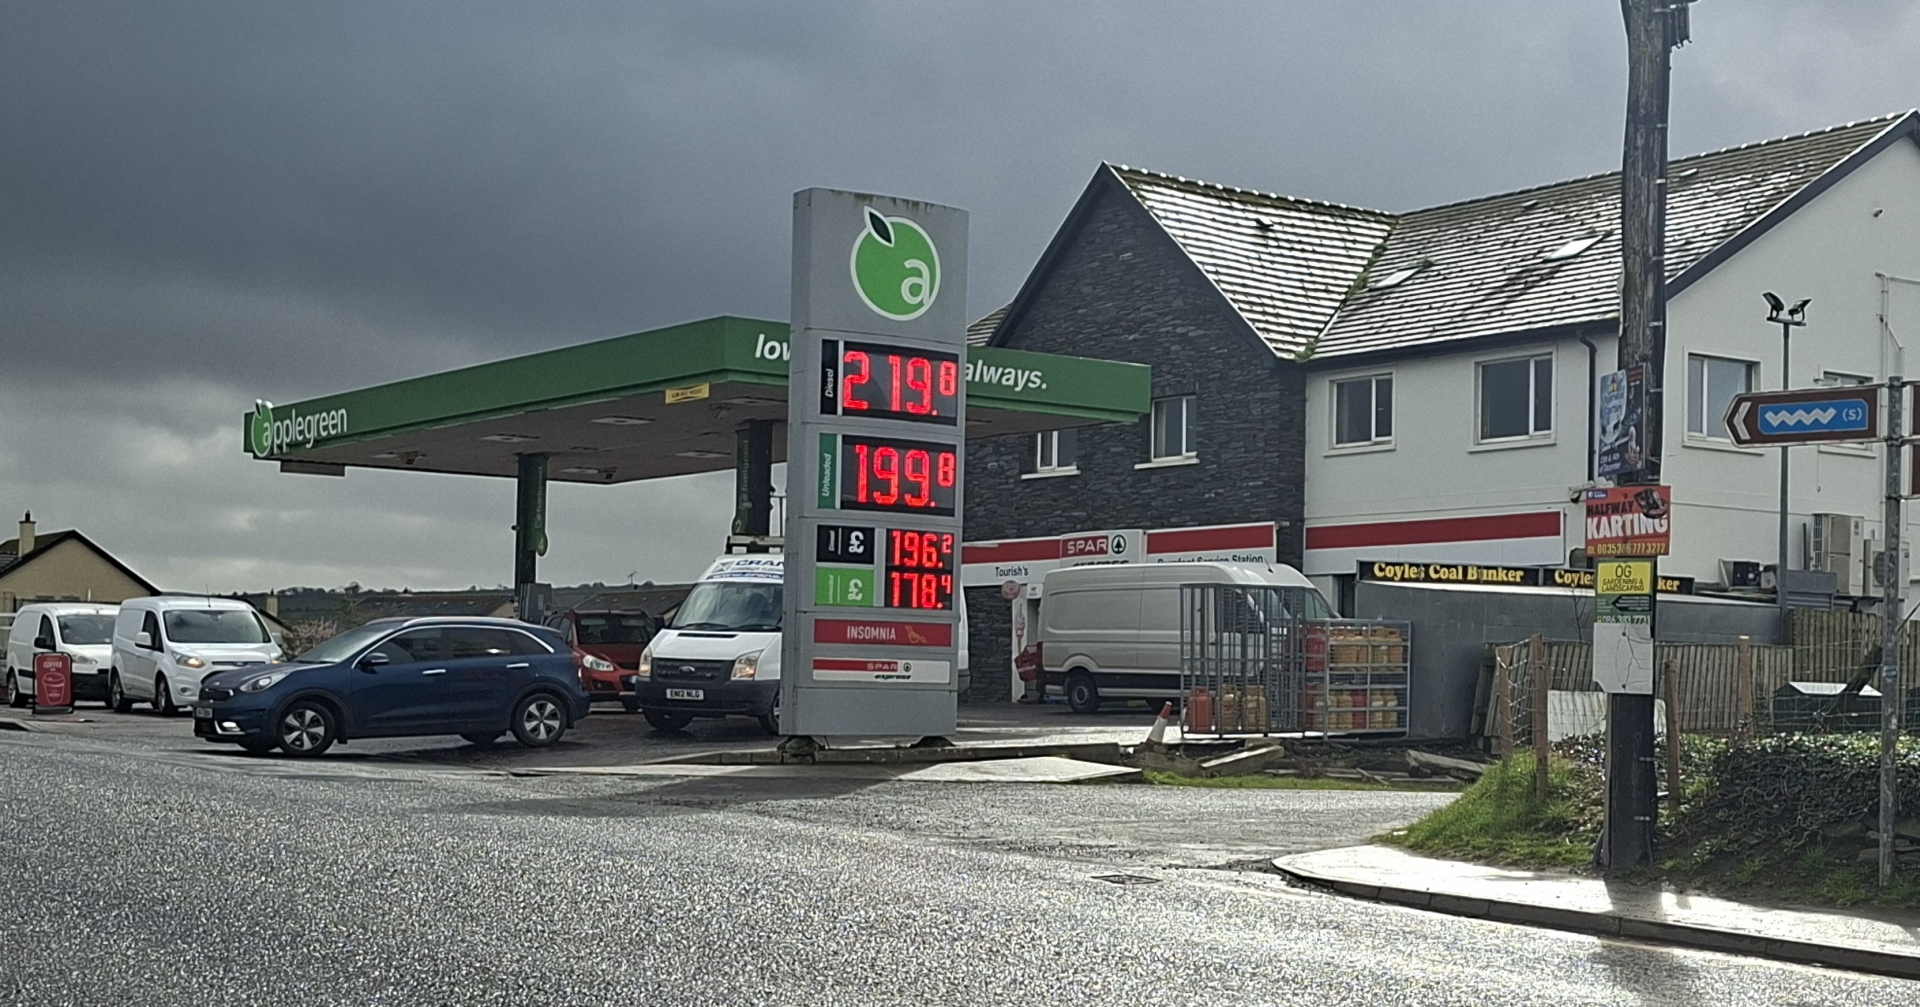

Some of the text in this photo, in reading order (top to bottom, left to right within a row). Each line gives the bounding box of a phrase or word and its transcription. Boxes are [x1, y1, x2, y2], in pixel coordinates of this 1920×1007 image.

[824, 368, 835, 398] Diesel
[964, 359, 1048, 392] always.
[1842, 407, 1863, 422] (S)
[263, 408, 348, 454] applegreen
[821, 452, 833, 497] Unleaded
[1587, 500, 1634, 516] HALFWAY
[1587, 512, 1668, 540] KARTING
[847, 530, 865, 554] £
[1067, 538, 1108, 554] SPAR
[995, 566, 1030, 578] Tourish's
[1373, 562, 1525, 583] Coyles Coal Bunker
[847, 578, 863, 601] £
[1601, 584, 1645, 592] LANDSCAPING
[846, 625, 897, 641] INSOMNIA
[866, 662, 898, 671] SPAR
